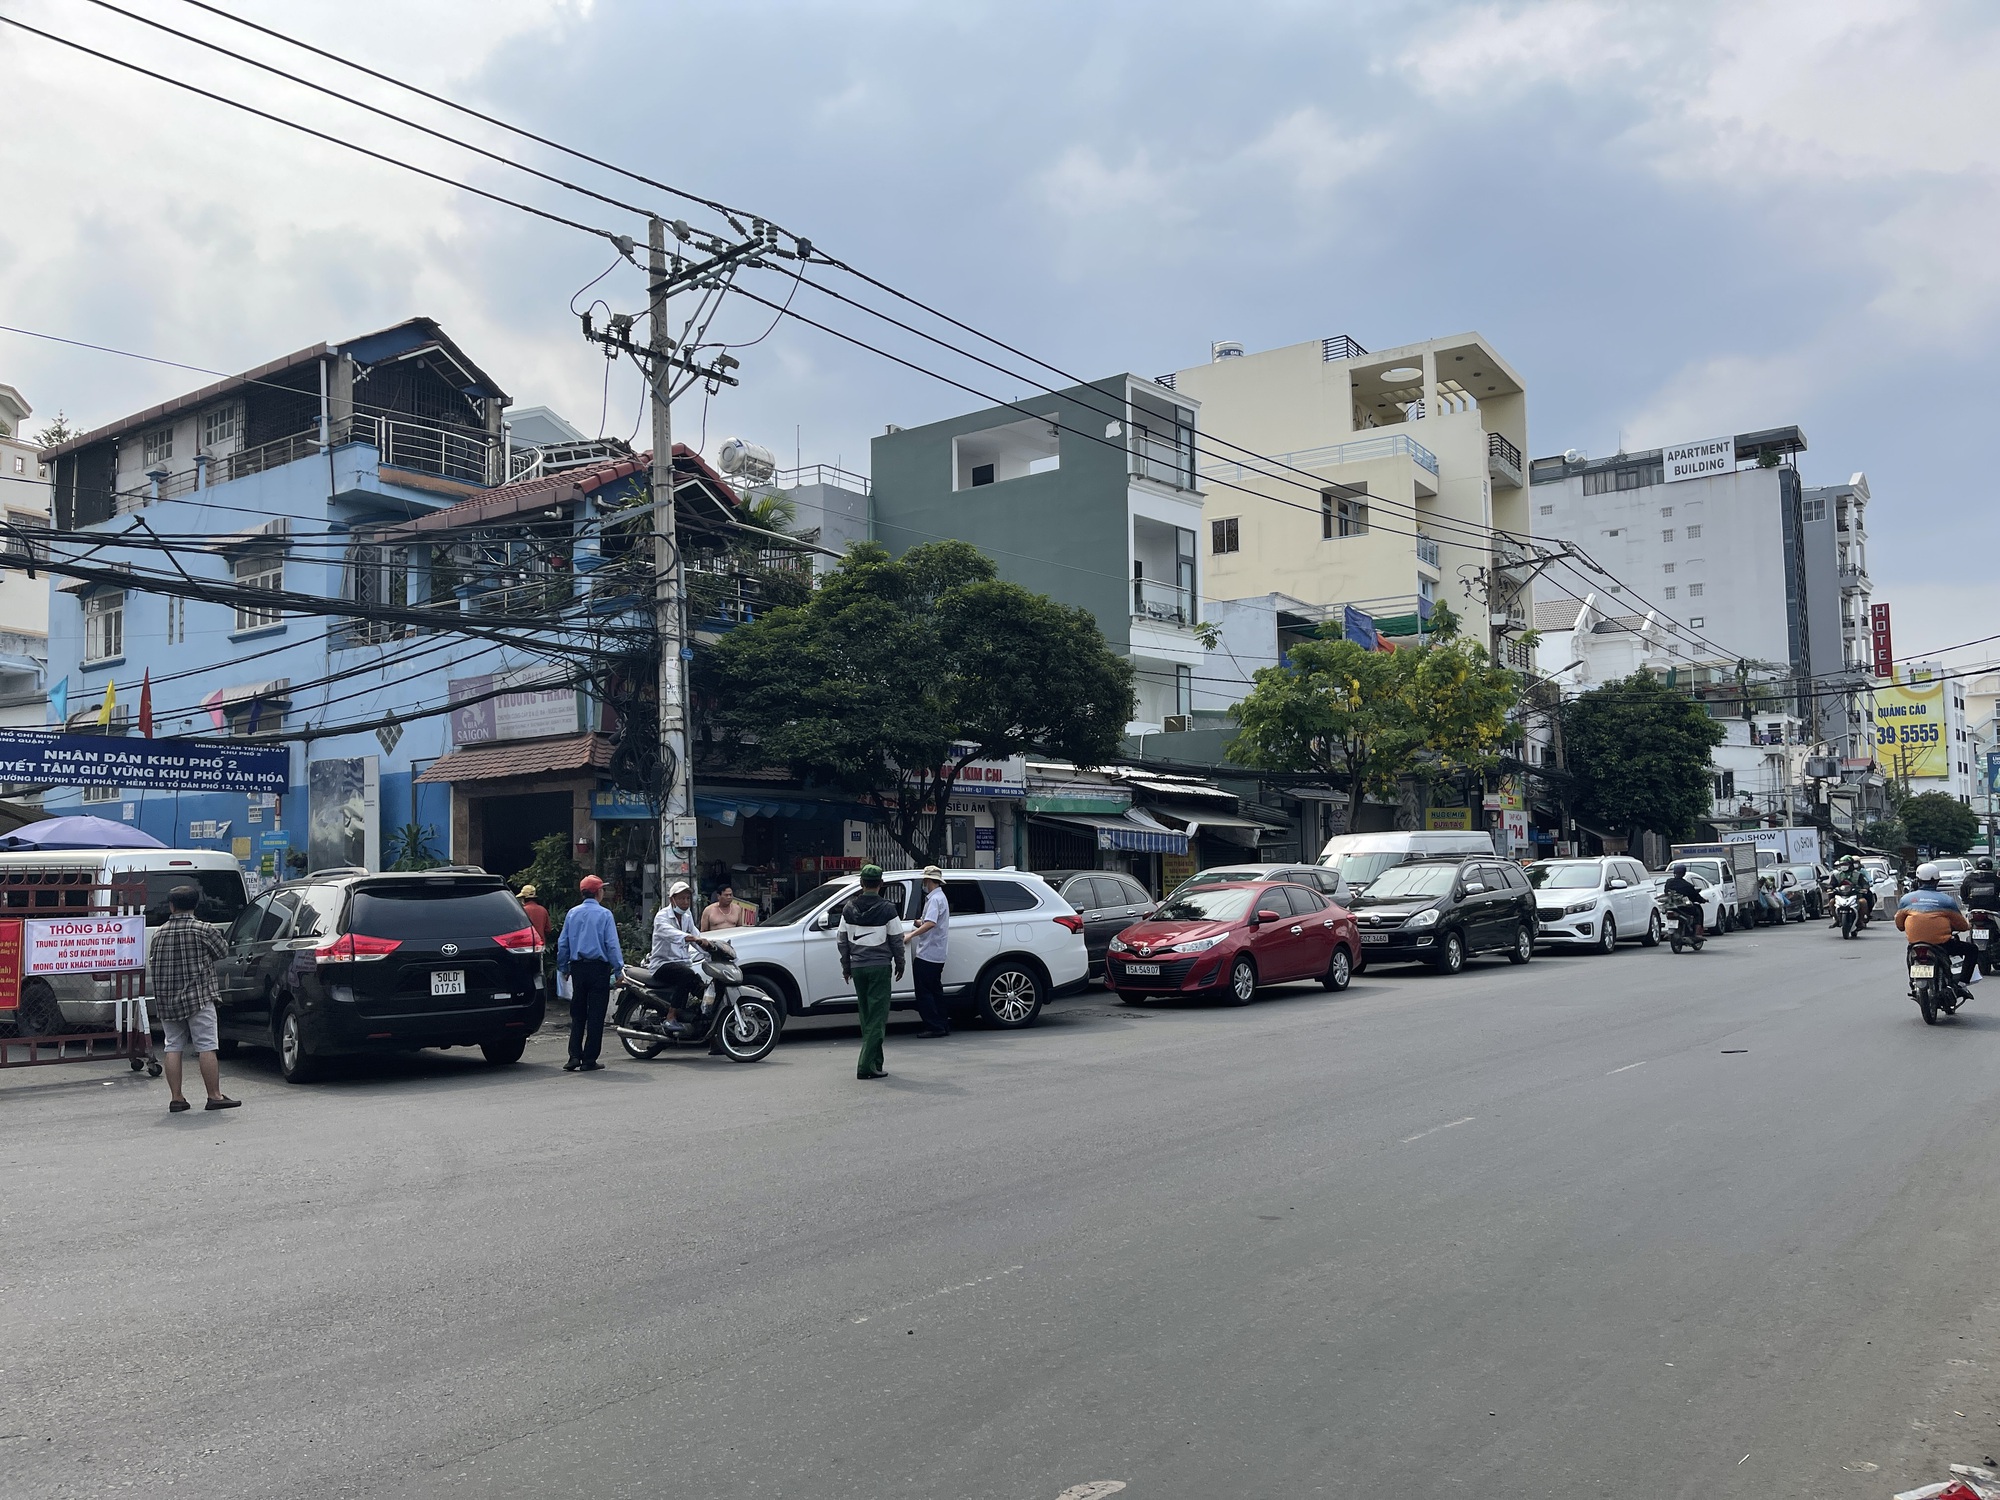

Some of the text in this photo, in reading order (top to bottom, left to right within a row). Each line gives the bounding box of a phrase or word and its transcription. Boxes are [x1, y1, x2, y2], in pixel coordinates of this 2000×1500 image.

[1667, 441, 1730, 462] APARTMENT
[1674, 458, 1725, 476] BUILDING
[1875, 605, 1888, 675] HOTEL
[1878, 703, 1927, 718] QUẢNG CÁO
[467, 721, 478, 729] BIA
[457, 728, 489, 740] SAIGON
[1877, 723, 1939, 745] 39 5555
[44, 749, 238, 769] NHÂN DÂN KHU PHỐ 2
[41, 761, 76, 774] TÂM
[80, 763, 109, 776] GIỮ
[112, 764, 155, 778] VỮNG
[158, 769, 190, 780] KHU
[193, 769, 223, 781] PHỐ
[226, 770, 254, 782] VĂN
[257, 771, 285, 783] HÓA
[963, 766, 983, 781] KIM
[985, 768, 1003, 783] CHI
[34, 775, 69, 784] HUỲNH
[93, 778, 119, 786] PHÁT
[181, 781, 199, 789] DÂN
[201, 781, 219, 790] PHỐ
[947, 802, 969, 812] SIÊU
[972, 802, 986, 812] ÂM
[1748, 833, 1776, 841] SHOW
[50, 921, 123, 935] THÔNG BÁO
[36, 940, 58, 948] TRUNG
[60, 938, 75, 947] TÂM
[101, 936, 116, 946] TIẾP
[117, 936, 136, 946] NHẬN
[99, 949, 116, 958] ĐỊNH
[33, 963, 54, 971] MONG
[70, 960, 93, 969] KHÁCH
[94, 959, 117, 968] THÔNG
[434, 982, 462, 994] 017.61
